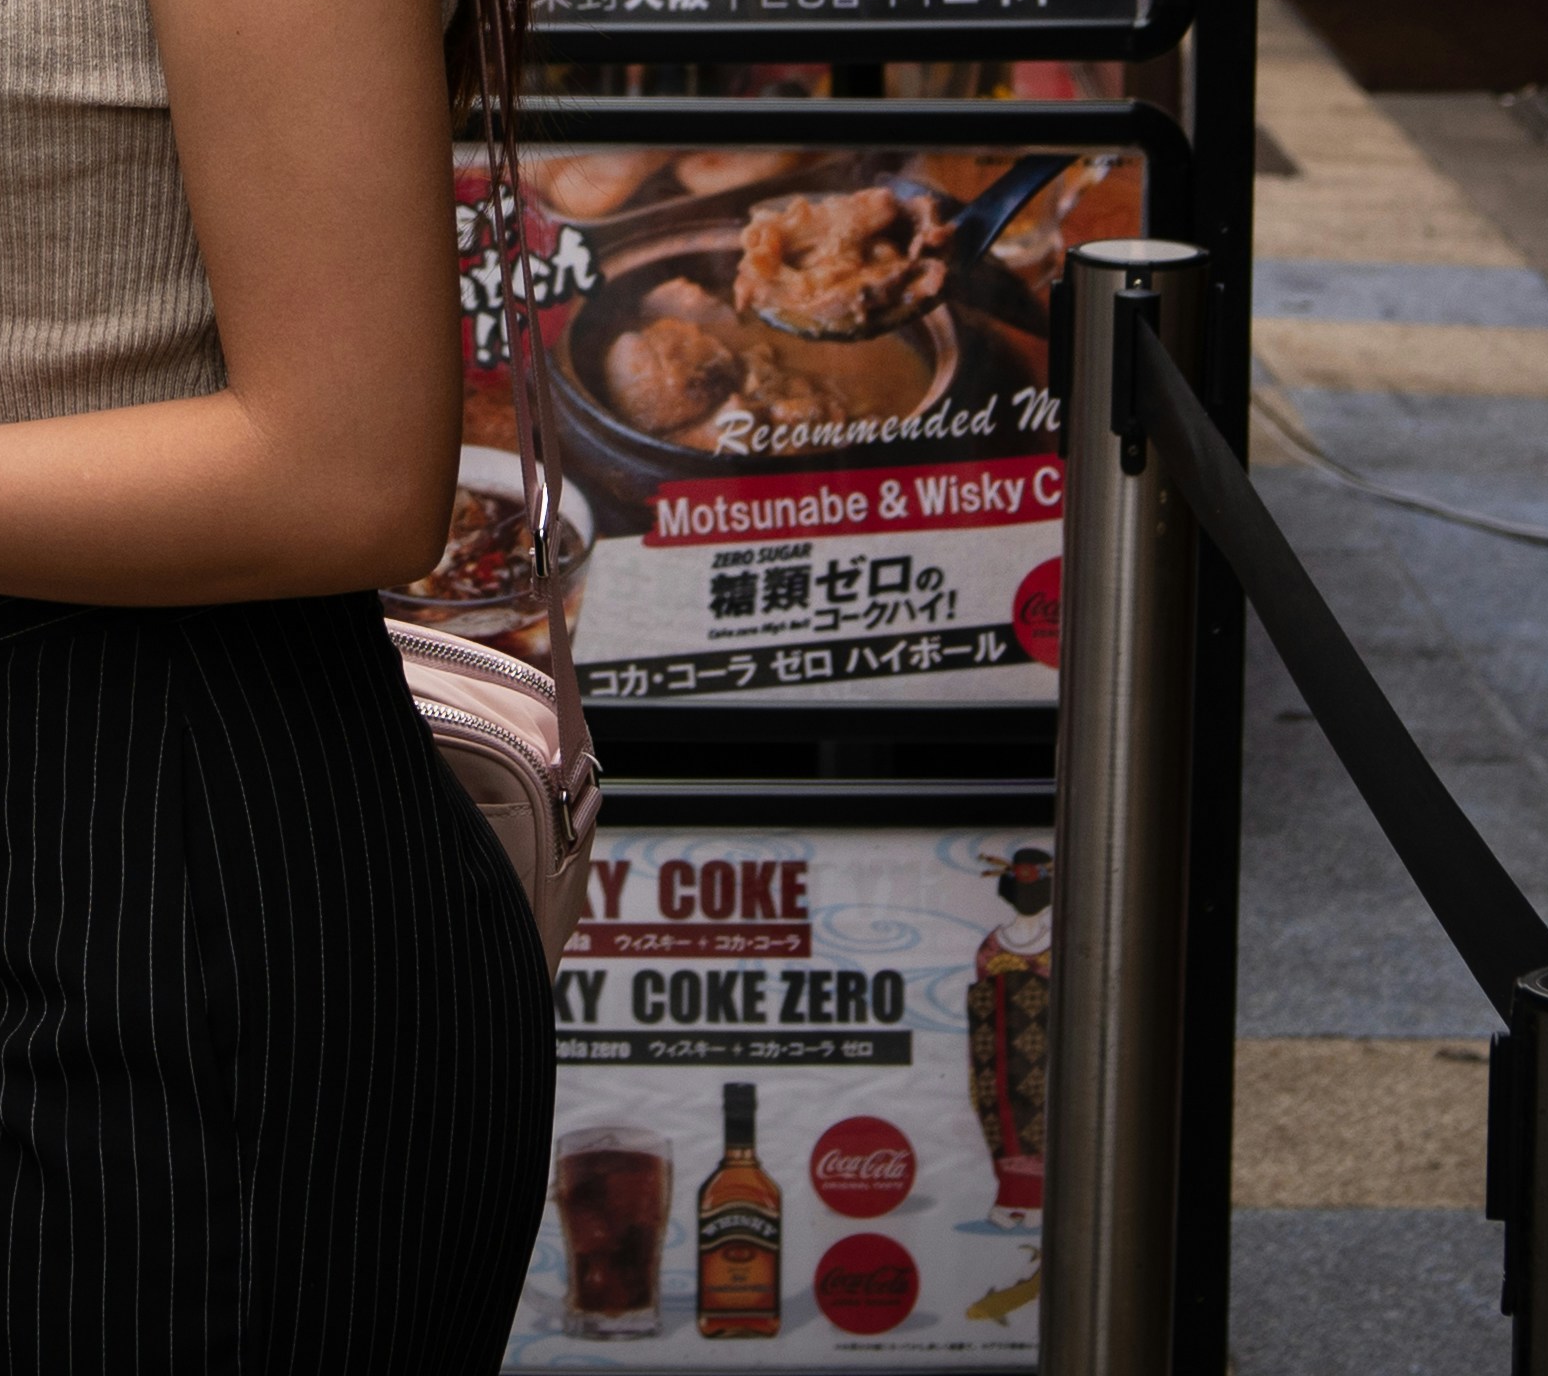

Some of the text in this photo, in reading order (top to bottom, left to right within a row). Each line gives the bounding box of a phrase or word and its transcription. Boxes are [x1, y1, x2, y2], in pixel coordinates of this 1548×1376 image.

[712, 394, 998, 457] Recommended
[656, 488, 867, 540] Motsunabe
[877, 481, 909, 519] &
[914, 471, 1025, 523] Wisky
[711, 542, 813, 570] ZERO SUGAR
[708, 554, 945, 620] 糖類ゼロの
[813, 589, 958, 633] コークハイ!
[587, 634, 1006, 699] コカ・コーラ ゼロ ハイボール
[657, 858, 809, 921] COKE
[713, 931, 803, 953] コカ・コーラ
[631, 968, 767, 1026] COKE
[778, 968, 907, 1026] ZERO
[815, 1148, 913, 1182] Coca-Cola
